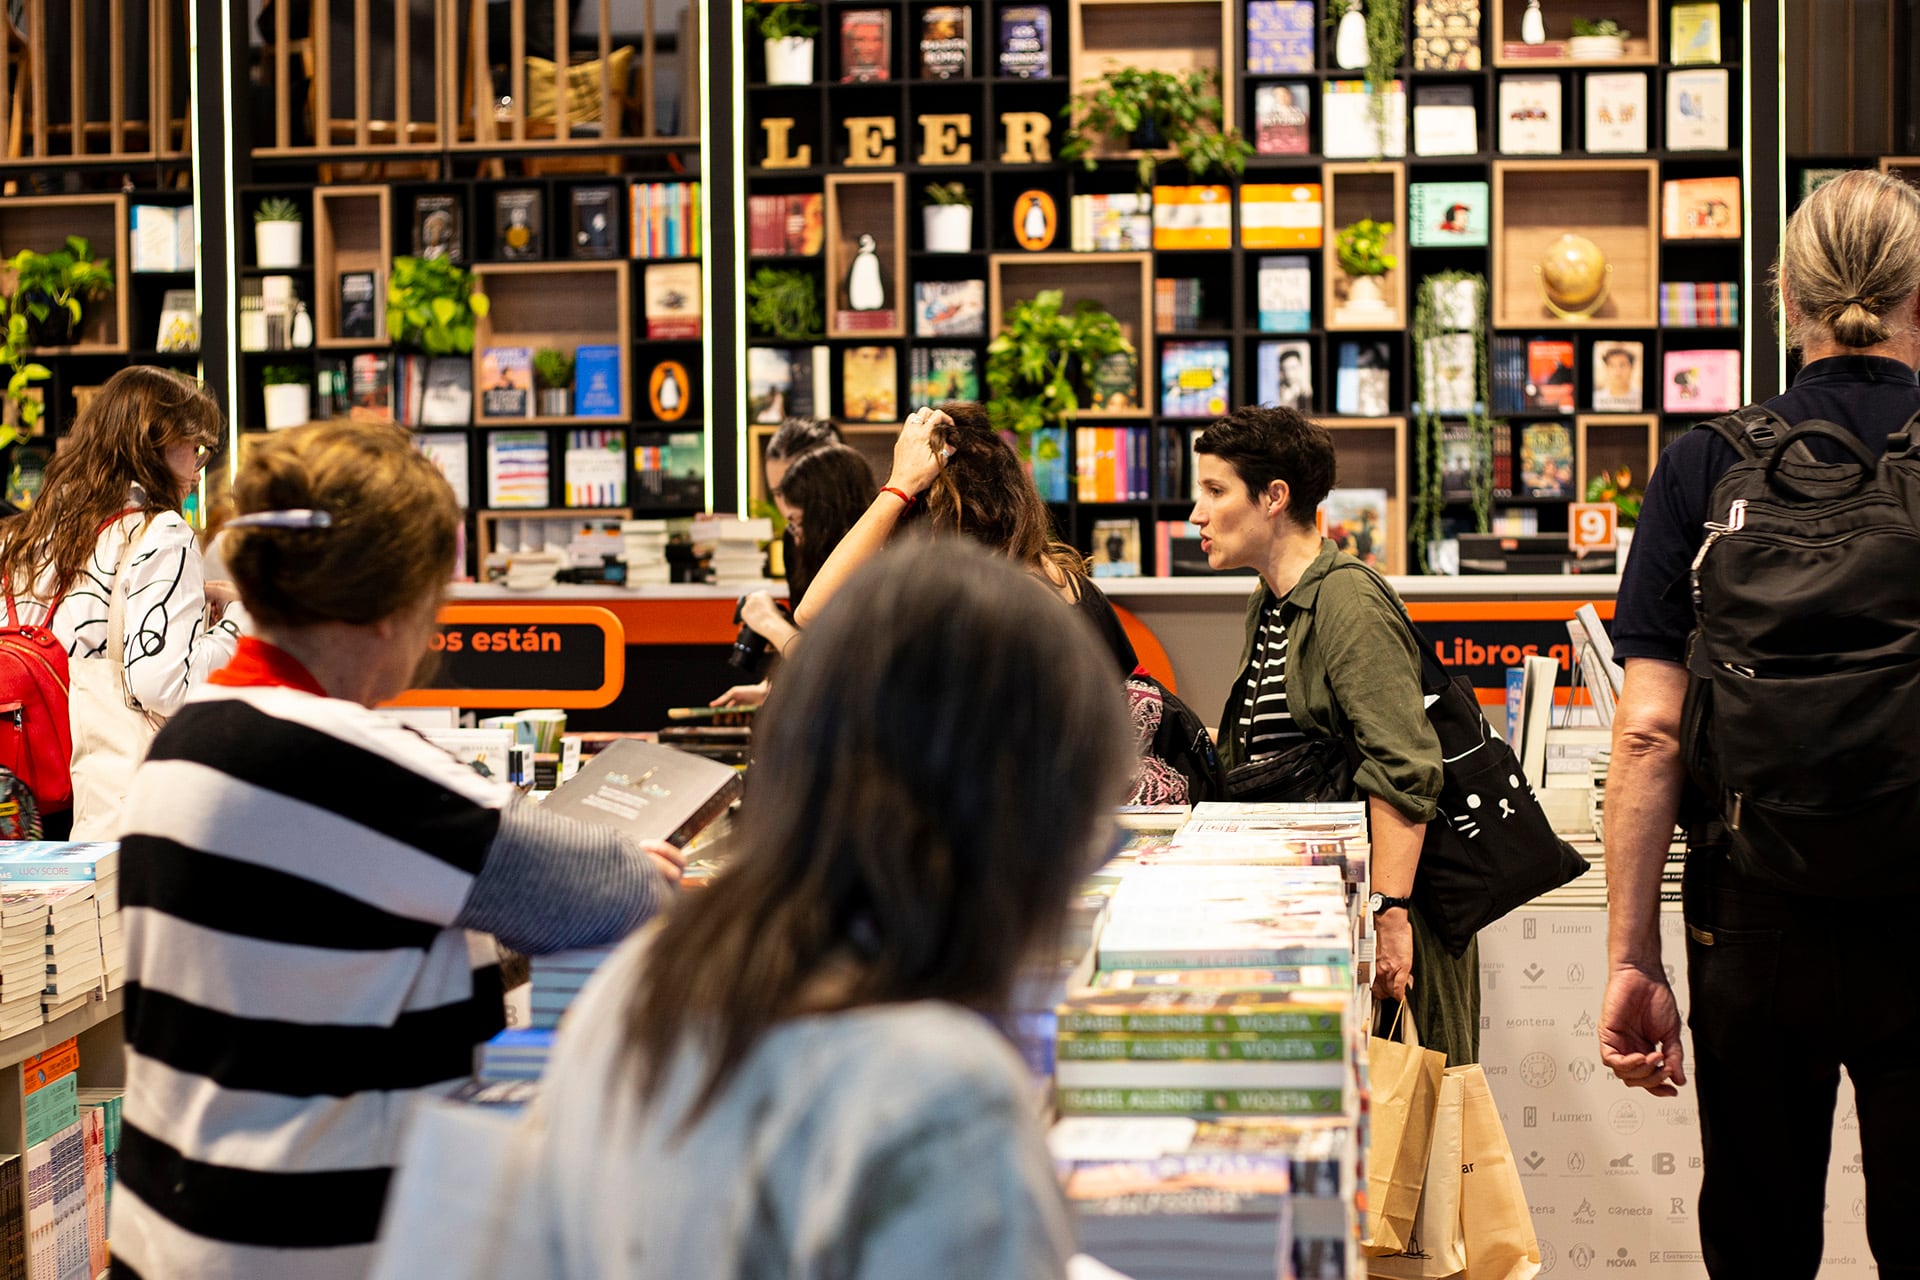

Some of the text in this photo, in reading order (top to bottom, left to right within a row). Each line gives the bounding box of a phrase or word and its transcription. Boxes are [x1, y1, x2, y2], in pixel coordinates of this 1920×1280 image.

[761, 111, 1052, 169] LEER
[1580, 510, 1606, 543] 9
[431, 626, 562, 652] os están
[1436, 637, 1538, 665] Libros
[41, 866, 69, 875] SCORE
[1551, 923, 1592, 934] Lumen
[1127, 1015, 1205, 1031] ALLENDE
[1237, 1015, 1312, 1031] VIOLETA
[1130, 1041, 1208, 1057] ALLENDE
[1240, 1041, 1315, 1057] VIOLETA
[1127, 1091, 1205, 1108] ALLENDE
[1237, 1091, 1312, 1108] VIOLETA
[1552, 1112, 1592, 1122] Lumen
[1461, 1163, 1474, 1174] ar
[1530, 1205, 1556, 1215] tena
[1606, 1259, 1637, 1268] NOVA
